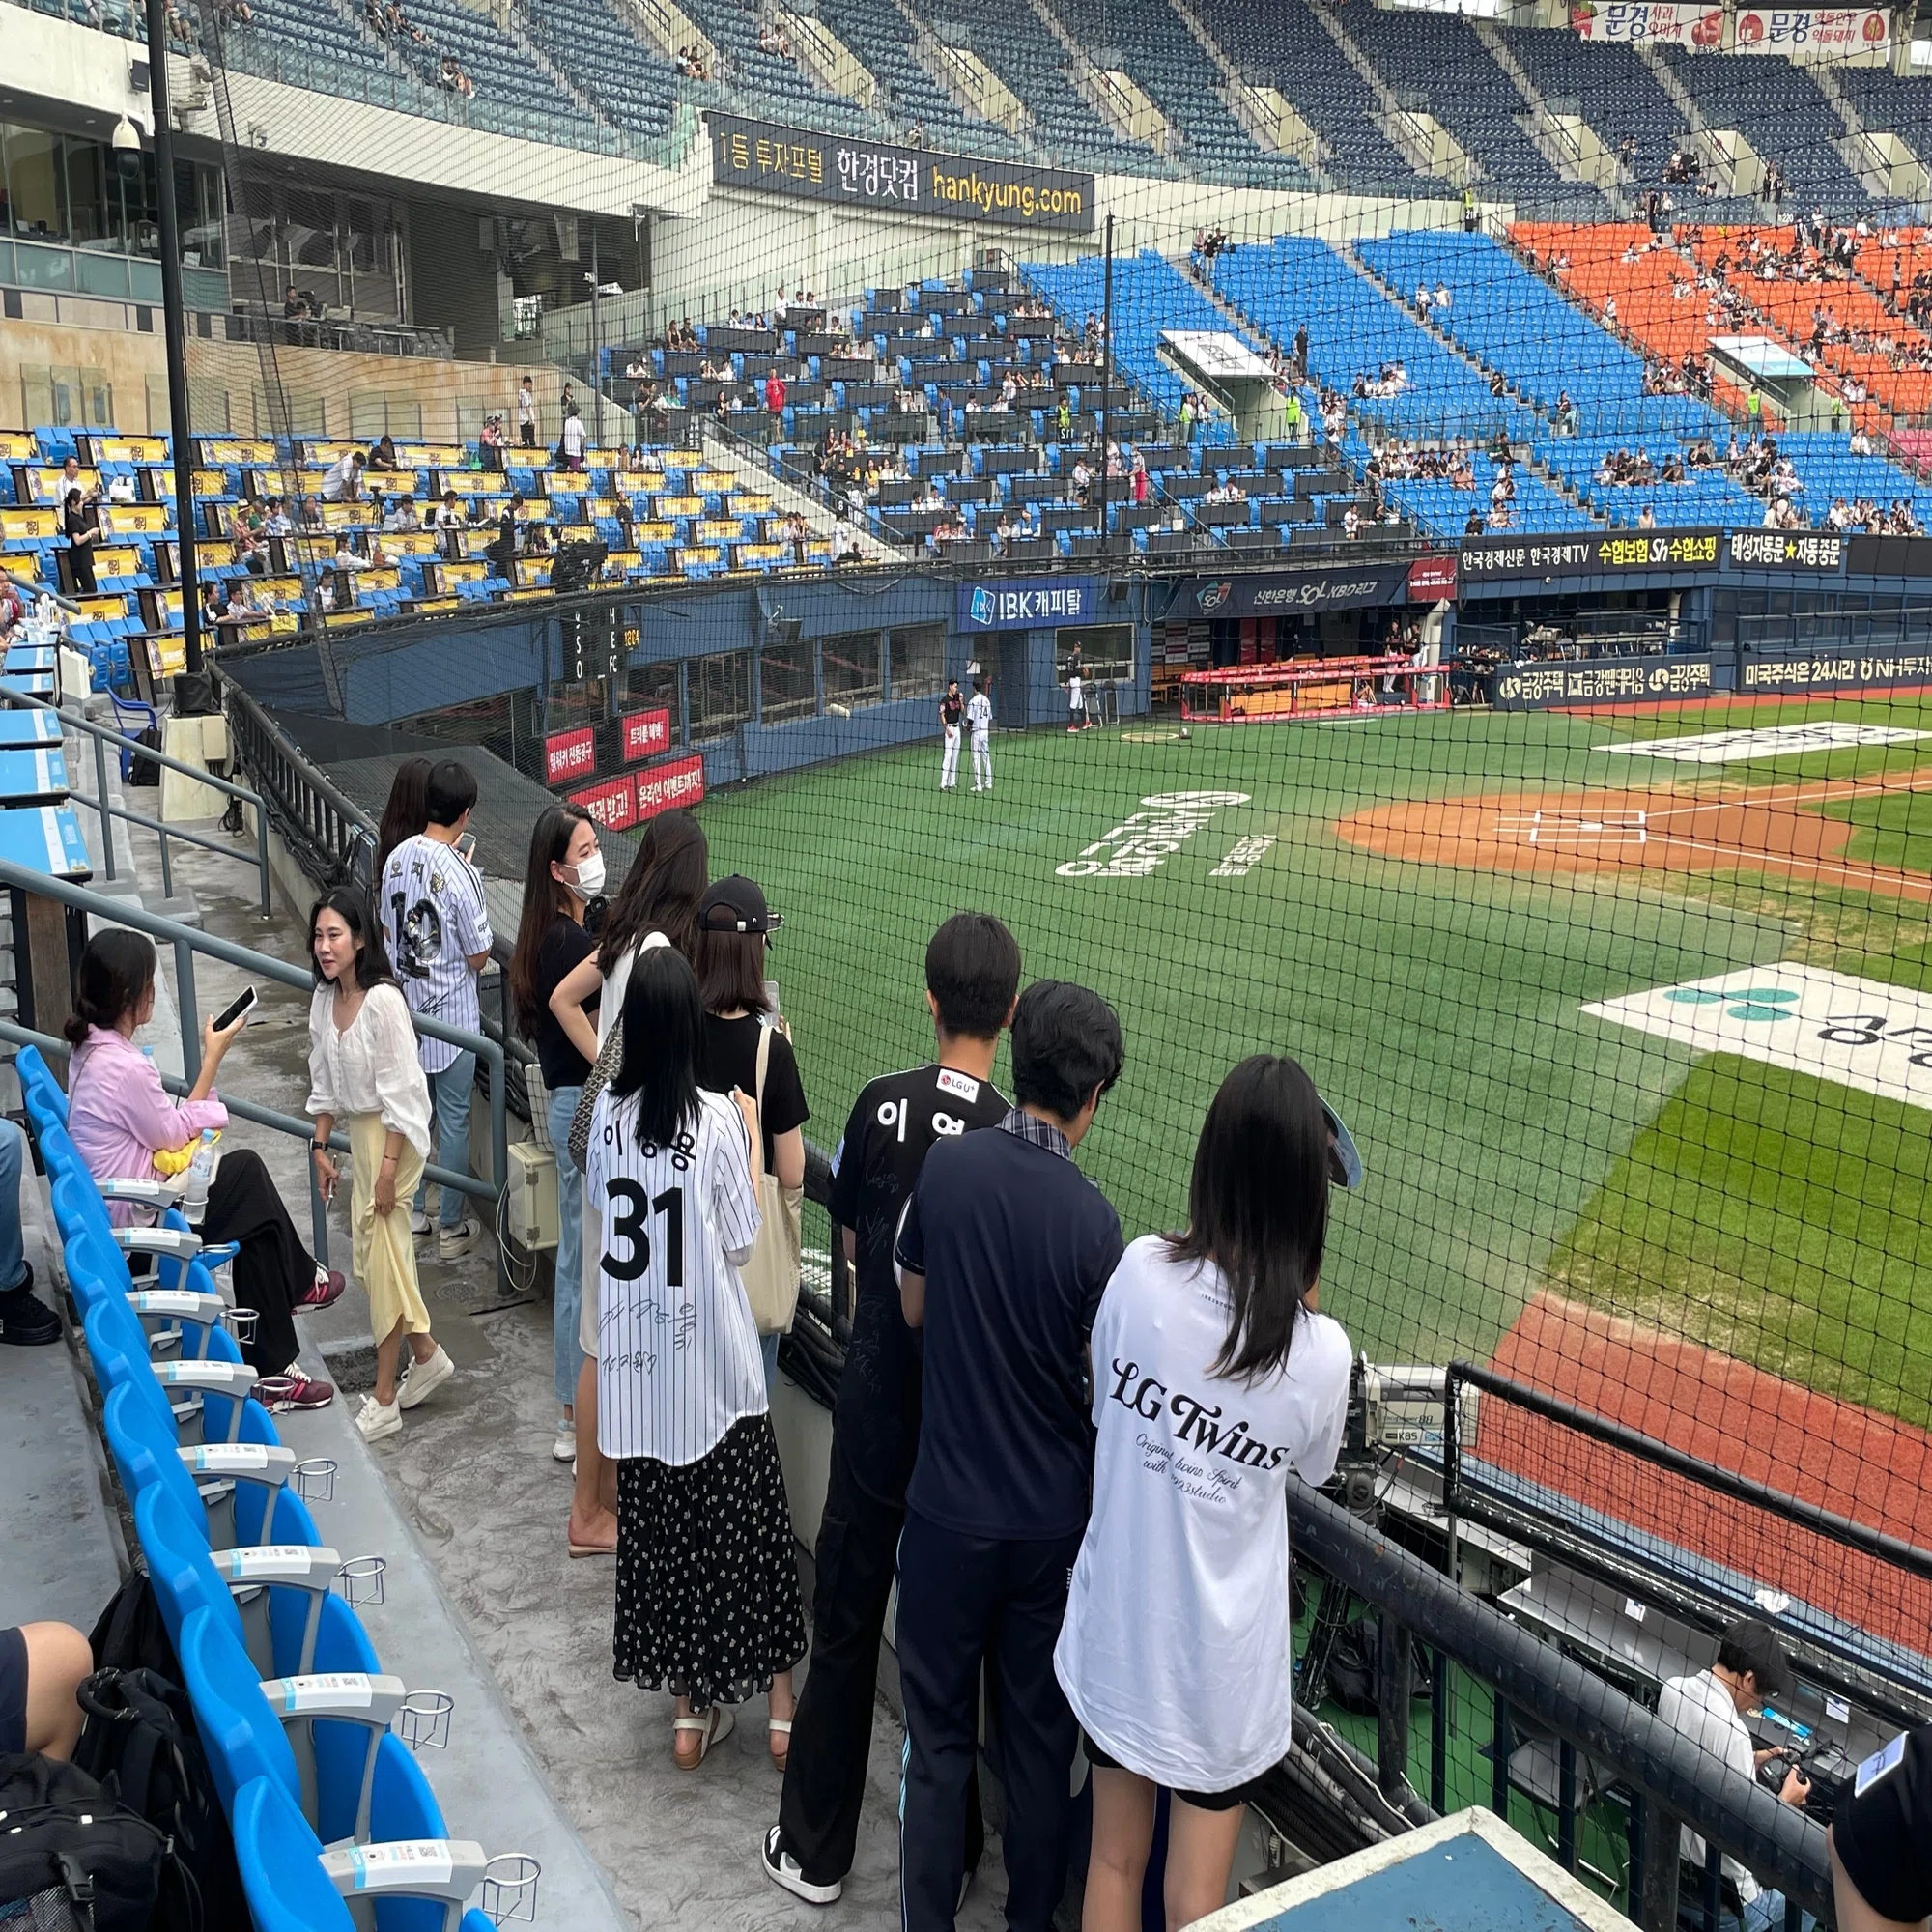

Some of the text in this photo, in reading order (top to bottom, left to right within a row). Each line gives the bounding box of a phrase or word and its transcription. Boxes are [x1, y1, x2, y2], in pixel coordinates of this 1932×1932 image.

[1605, 5, 1649, 37] 문경
[1649, 6, 1674, 20] 사과
[1648, 21, 1683, 38] 오미자
[1770, 13, 1811, 43] 문경
[720, 132, 1082, 217] 1등 투자포털 한경닷컴 hankyung.com
[1462, 544, 1589, 570] 한국경제신문 한국경제TV
[1598, 536, 1717, 564] 수협보험 Sh 수협쇼핑
[1796, 537, 1840, 566] 자동중문
[1254, 588, 1297, 605] 신한은행
[1296, 580, 1328, 606] SOL
[1520, 670, 1564, 699] 금강주택
[1669, 664, 1711, 692] 금강주택
[1746, 659, 1810, 685] 미국주식은
[1811, 659, 1856, 681] 24시간
[569, 741, 592, 767] 전동공구
[639, 768, 702, 809] 온라인 이벤트까지!
[599, 1177, 683, 1287] 31
[1110, 1358, 1290, 1470] LG Twins
[1399, 1432, 1418, 1441] KBS
[1136, 1433, 1243, 1490] Original twins Spirit
[1143, 1460, 1227, 1504] with 1993studio
